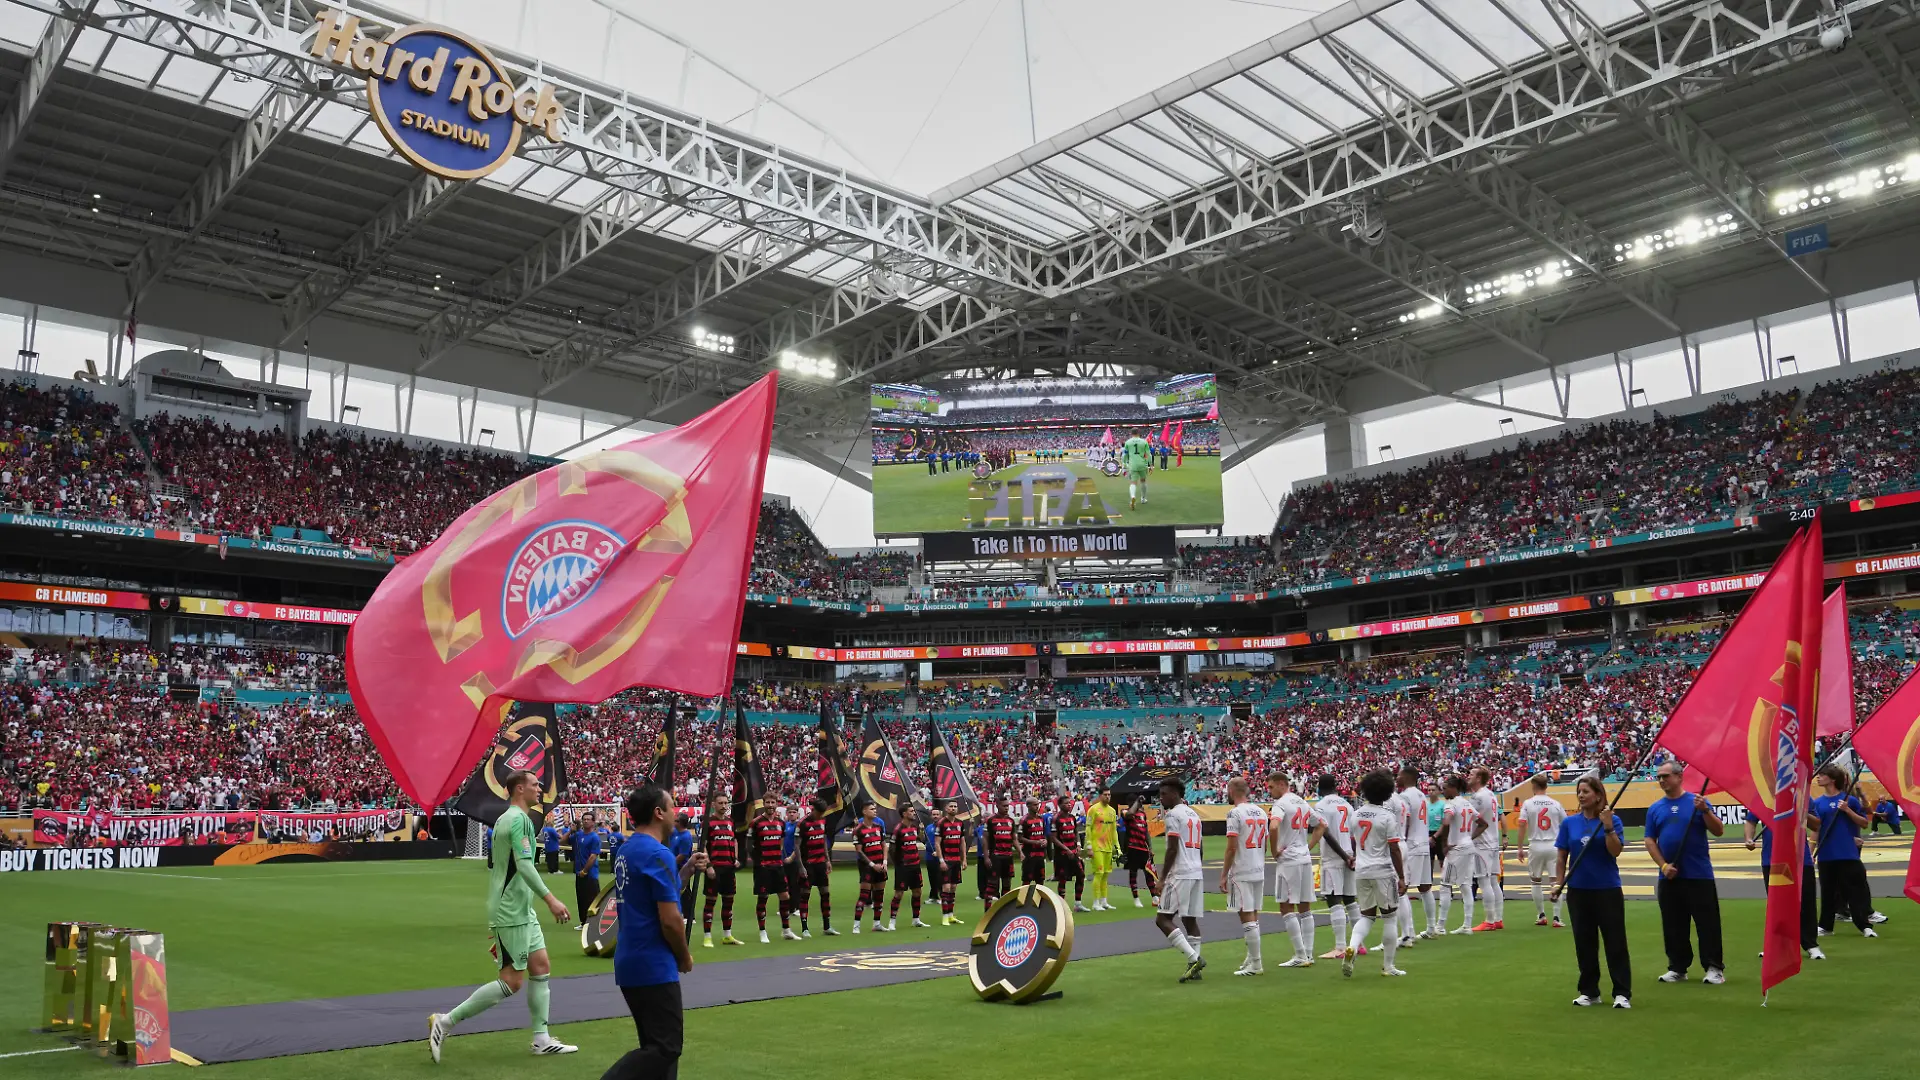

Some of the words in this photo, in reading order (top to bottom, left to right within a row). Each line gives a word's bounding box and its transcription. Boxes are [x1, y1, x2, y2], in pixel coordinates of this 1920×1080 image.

[310, 10, 450, 95] Hard
[449, 55, 566, 143] Rock
[400, 108, 490, 150] STADIUM
[1792, 233, 1822, 248] FIFA
[1883, 357, 1901, 368] 317
[1720, 391, 1737, 401] 316
[967, 476, 1112, 528] FIFA
[1789, 508, 1816, 521] 2:40
[11, 514, 58, 528] MANNY
[61, 520, 126, 536] FERNANDEZ
[129, 527, 145, 537] 75
[1647, 531, 1665, 541] JOE
[1665, 526, 1696, 538] ROBBIE
[972, 537, 1009, 555] Take
[1013, 535, 1025, 552] It
[1027, 535, 1046, 553] To
[1050, 534, 1078, 552] The
[1082, 532, 1127, 551] World
[1215, 537, 1229, 545] 312
[262, 541, 297, 554] JASON
[300, 546, 340, 558] TAYLOR
[1499, 553, 1519, 563] PAUL
[1520, 548, 1559, 560] WARFIELD
[1562, 544, 1575, 553] 42
[1402, 568, 1432, 578] LANGER
[1437, 564, 1449, 572] 62
[1855, 562, 1869, 573] CR
[1300, 584, 1323, 593] GRIESE
[1697, 583, 1709, 593] FC
[1710, 578, 1743, 591] BAYERN
[35, 588, 50, 601] CR
[53, 589, 108, 605] FLAMENGO
[809, 599, 823, 607] JAKE
[824, 602, 842, 610] SCOTT
[1045, 599, 1070, 607] MOORE
[1630, 591, 1636, 602] V
[200, 600, 206, 612] V
[904, 603, 921, 611] DICK
[922, 602, 957, 610] ANDERSON
[1508, 608, 1519, 618] CR
[1520, 602, 1559, 616] FLAMENGO
[275, 607, 287, 619] FC
[288, 608, 321, 621] BAYERN
[323, 610, 358, 624] MÜNCHE
[1392, 623, 1400, 632] FC
[1401, 619, 1426, 631] BAYERN
[1427, 615, 1460, 627] MÜNCHEN
[1126, 643, 1135, 652] FC
[1136, 642, 1162, 651] BAYERN
[1163, 639, 1195, 650] MÜNCHEN
[1242, 640, 1252, 648] CR
[1253, 637, 1287, 647] FLAMENGO
[846, 651, 855, 659] FC
[855, 651, 881, 659] BAYERN
[882, 649, 915, 658] MÜNCHEN
[962, 647, 972, 656] CR
[973, 647, 1008, 656] FLAMENGO
[1291, 807, 1311, 830] 44
[1336, 806, 1349, 833] 2
[1418, 799, 1427, 825] 4
[1537, 807, 1552, 831] 6
[1185, 818, 1202, 849] 11
[1244, 819, 1267, 849] 27
[1358, 820, 1373, 850] 7
[1, 850, 37, 872] BUY
[43, 848, 114, 871] TICKETS
[119, 846, 160, 868] NOW
[1001, 925, 1013, 938] FC
[1013, 918, 1036, 939] BAYERN
[997, 946, 1031, 966] MÜNCHEN
